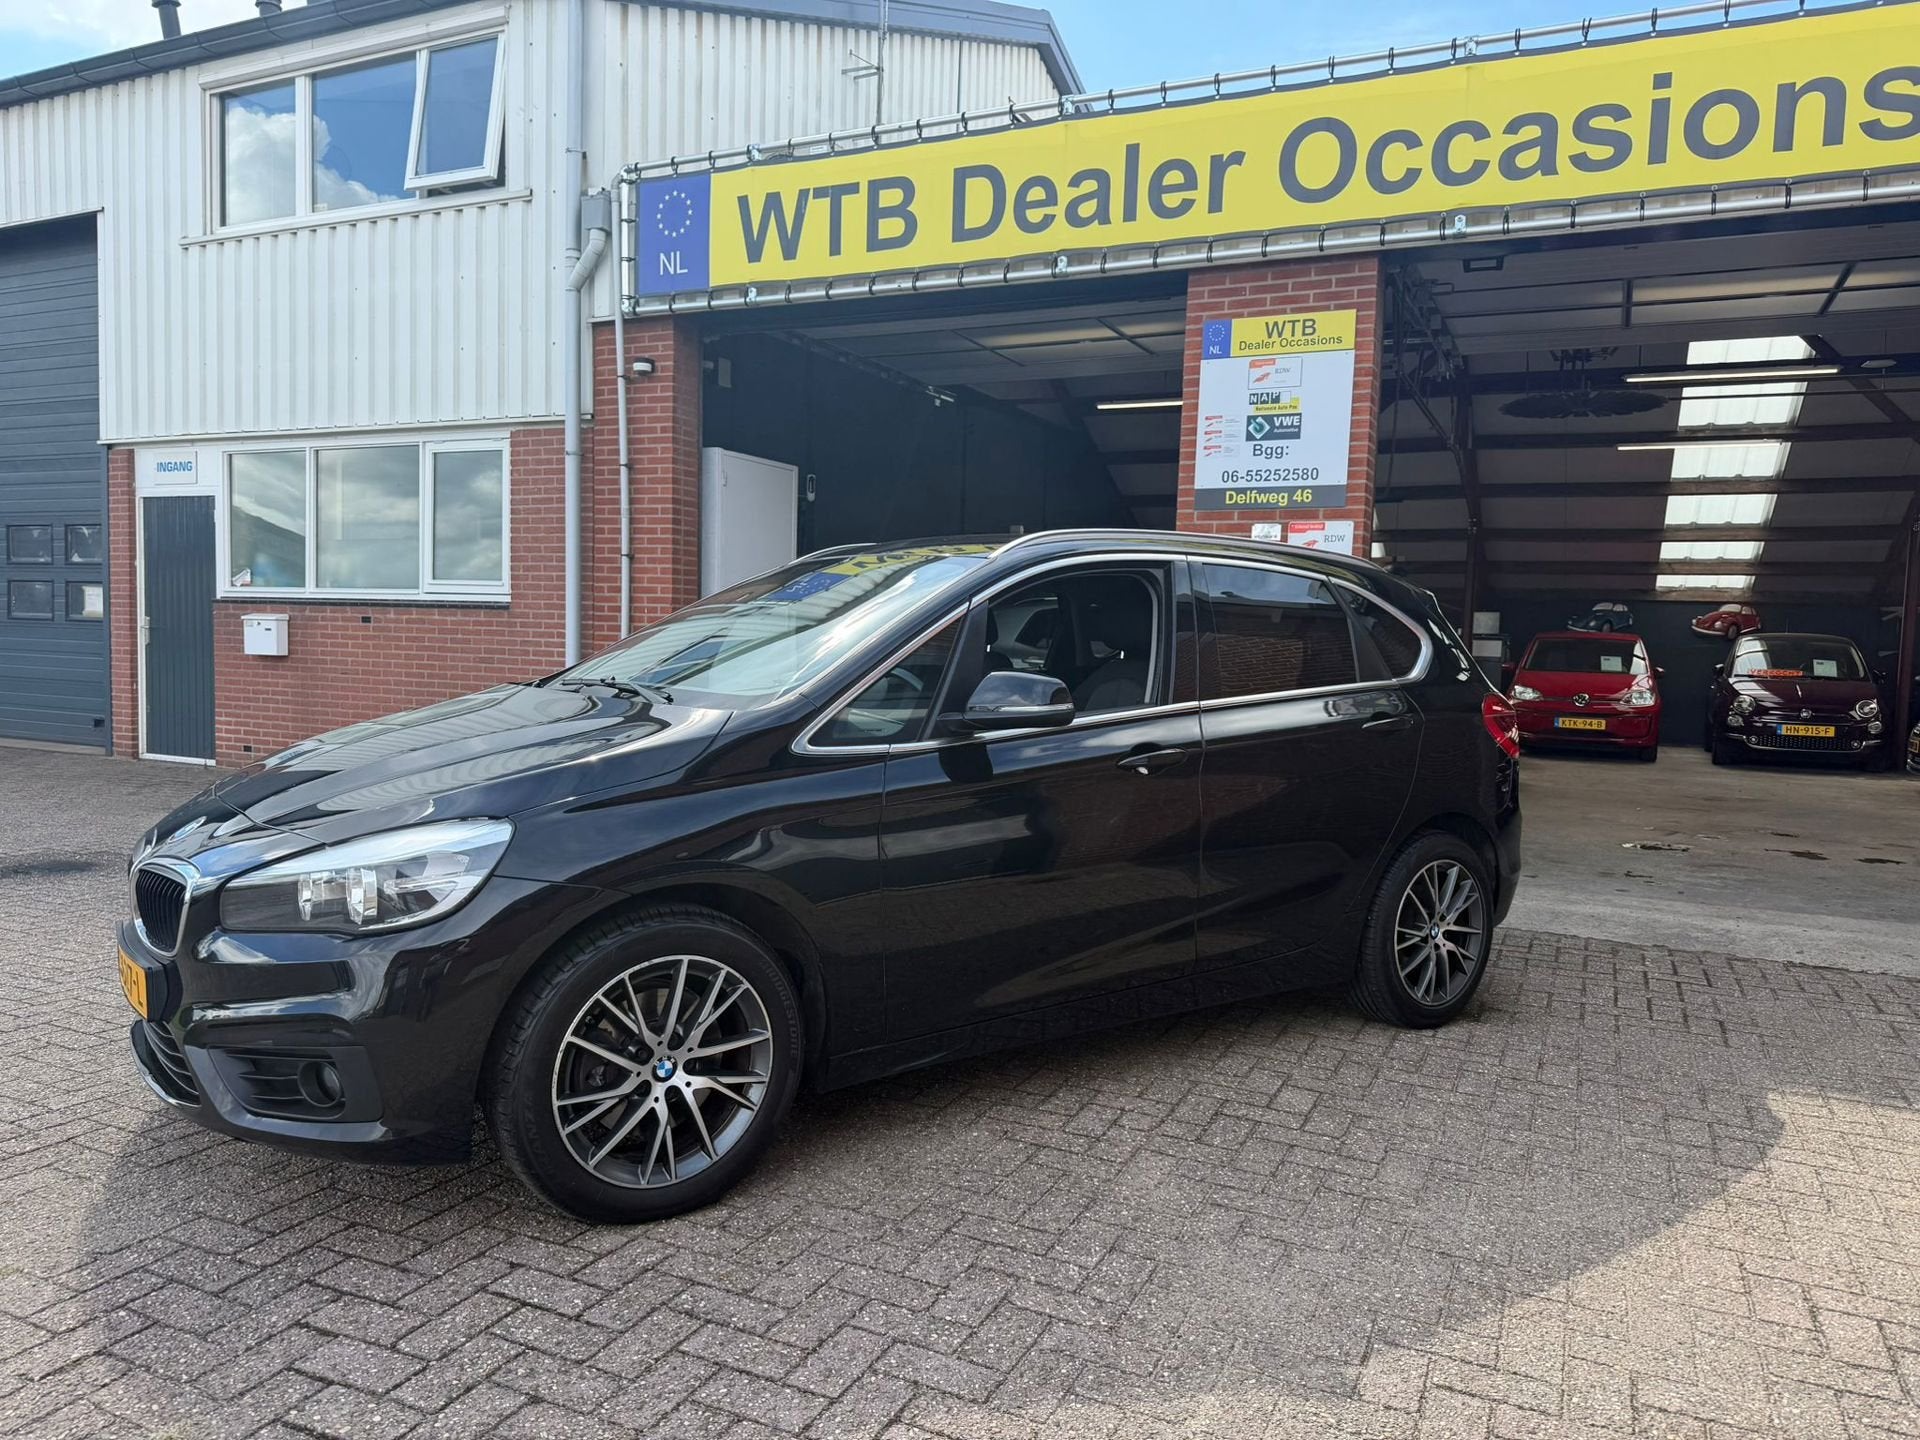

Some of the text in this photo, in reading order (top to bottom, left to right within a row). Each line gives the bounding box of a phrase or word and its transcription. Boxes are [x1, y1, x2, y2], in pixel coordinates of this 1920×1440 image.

[737, 64, 1920, 264] WTB Dealer Occasions
[659, 251, 688, 275] NL
[1265, 318, 1317, 339] WTB
[1209, 346, 1223, 355] NL
[1239, 335, 1343, 351] Dealer Occasions
[1250, 391, 1280, 404] NAP
[1273, 416, 1301, 427] VWE
[1252, 443, 1289, 459] Bgg:
[156, 461, 193, 473] INGANG
[1221, 467, 1319, 483] 06-55252580
[1225, 488, 1313, 506] Delfweg 46
[1323, 534, 1346, 543] RDW
[1785, 726, 1831, 736] HN-915-F
